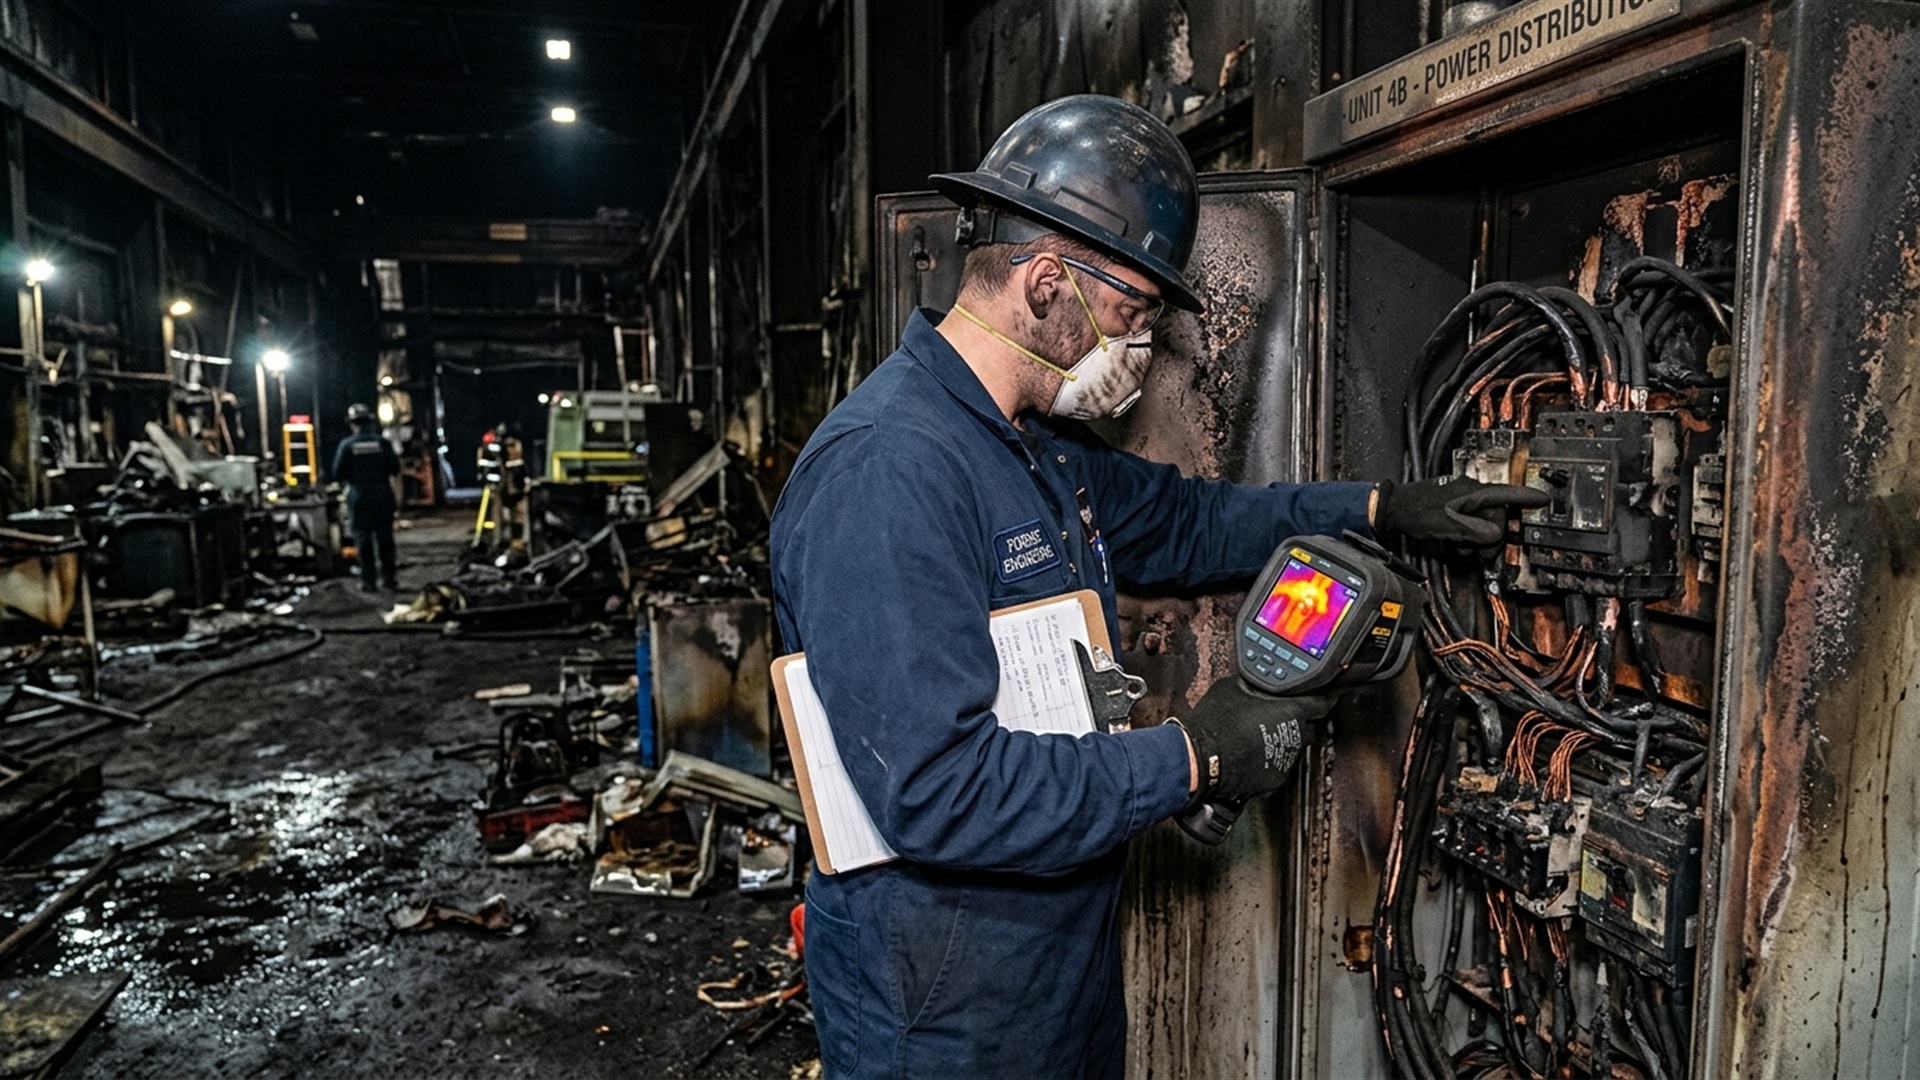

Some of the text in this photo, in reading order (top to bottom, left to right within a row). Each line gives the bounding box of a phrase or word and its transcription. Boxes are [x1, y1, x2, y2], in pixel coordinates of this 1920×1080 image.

[1349, 85, 1383, 124] UNIT
[1387, 75, 1407, 107] 4B
[1424, 39, 1491, 95] POWER
